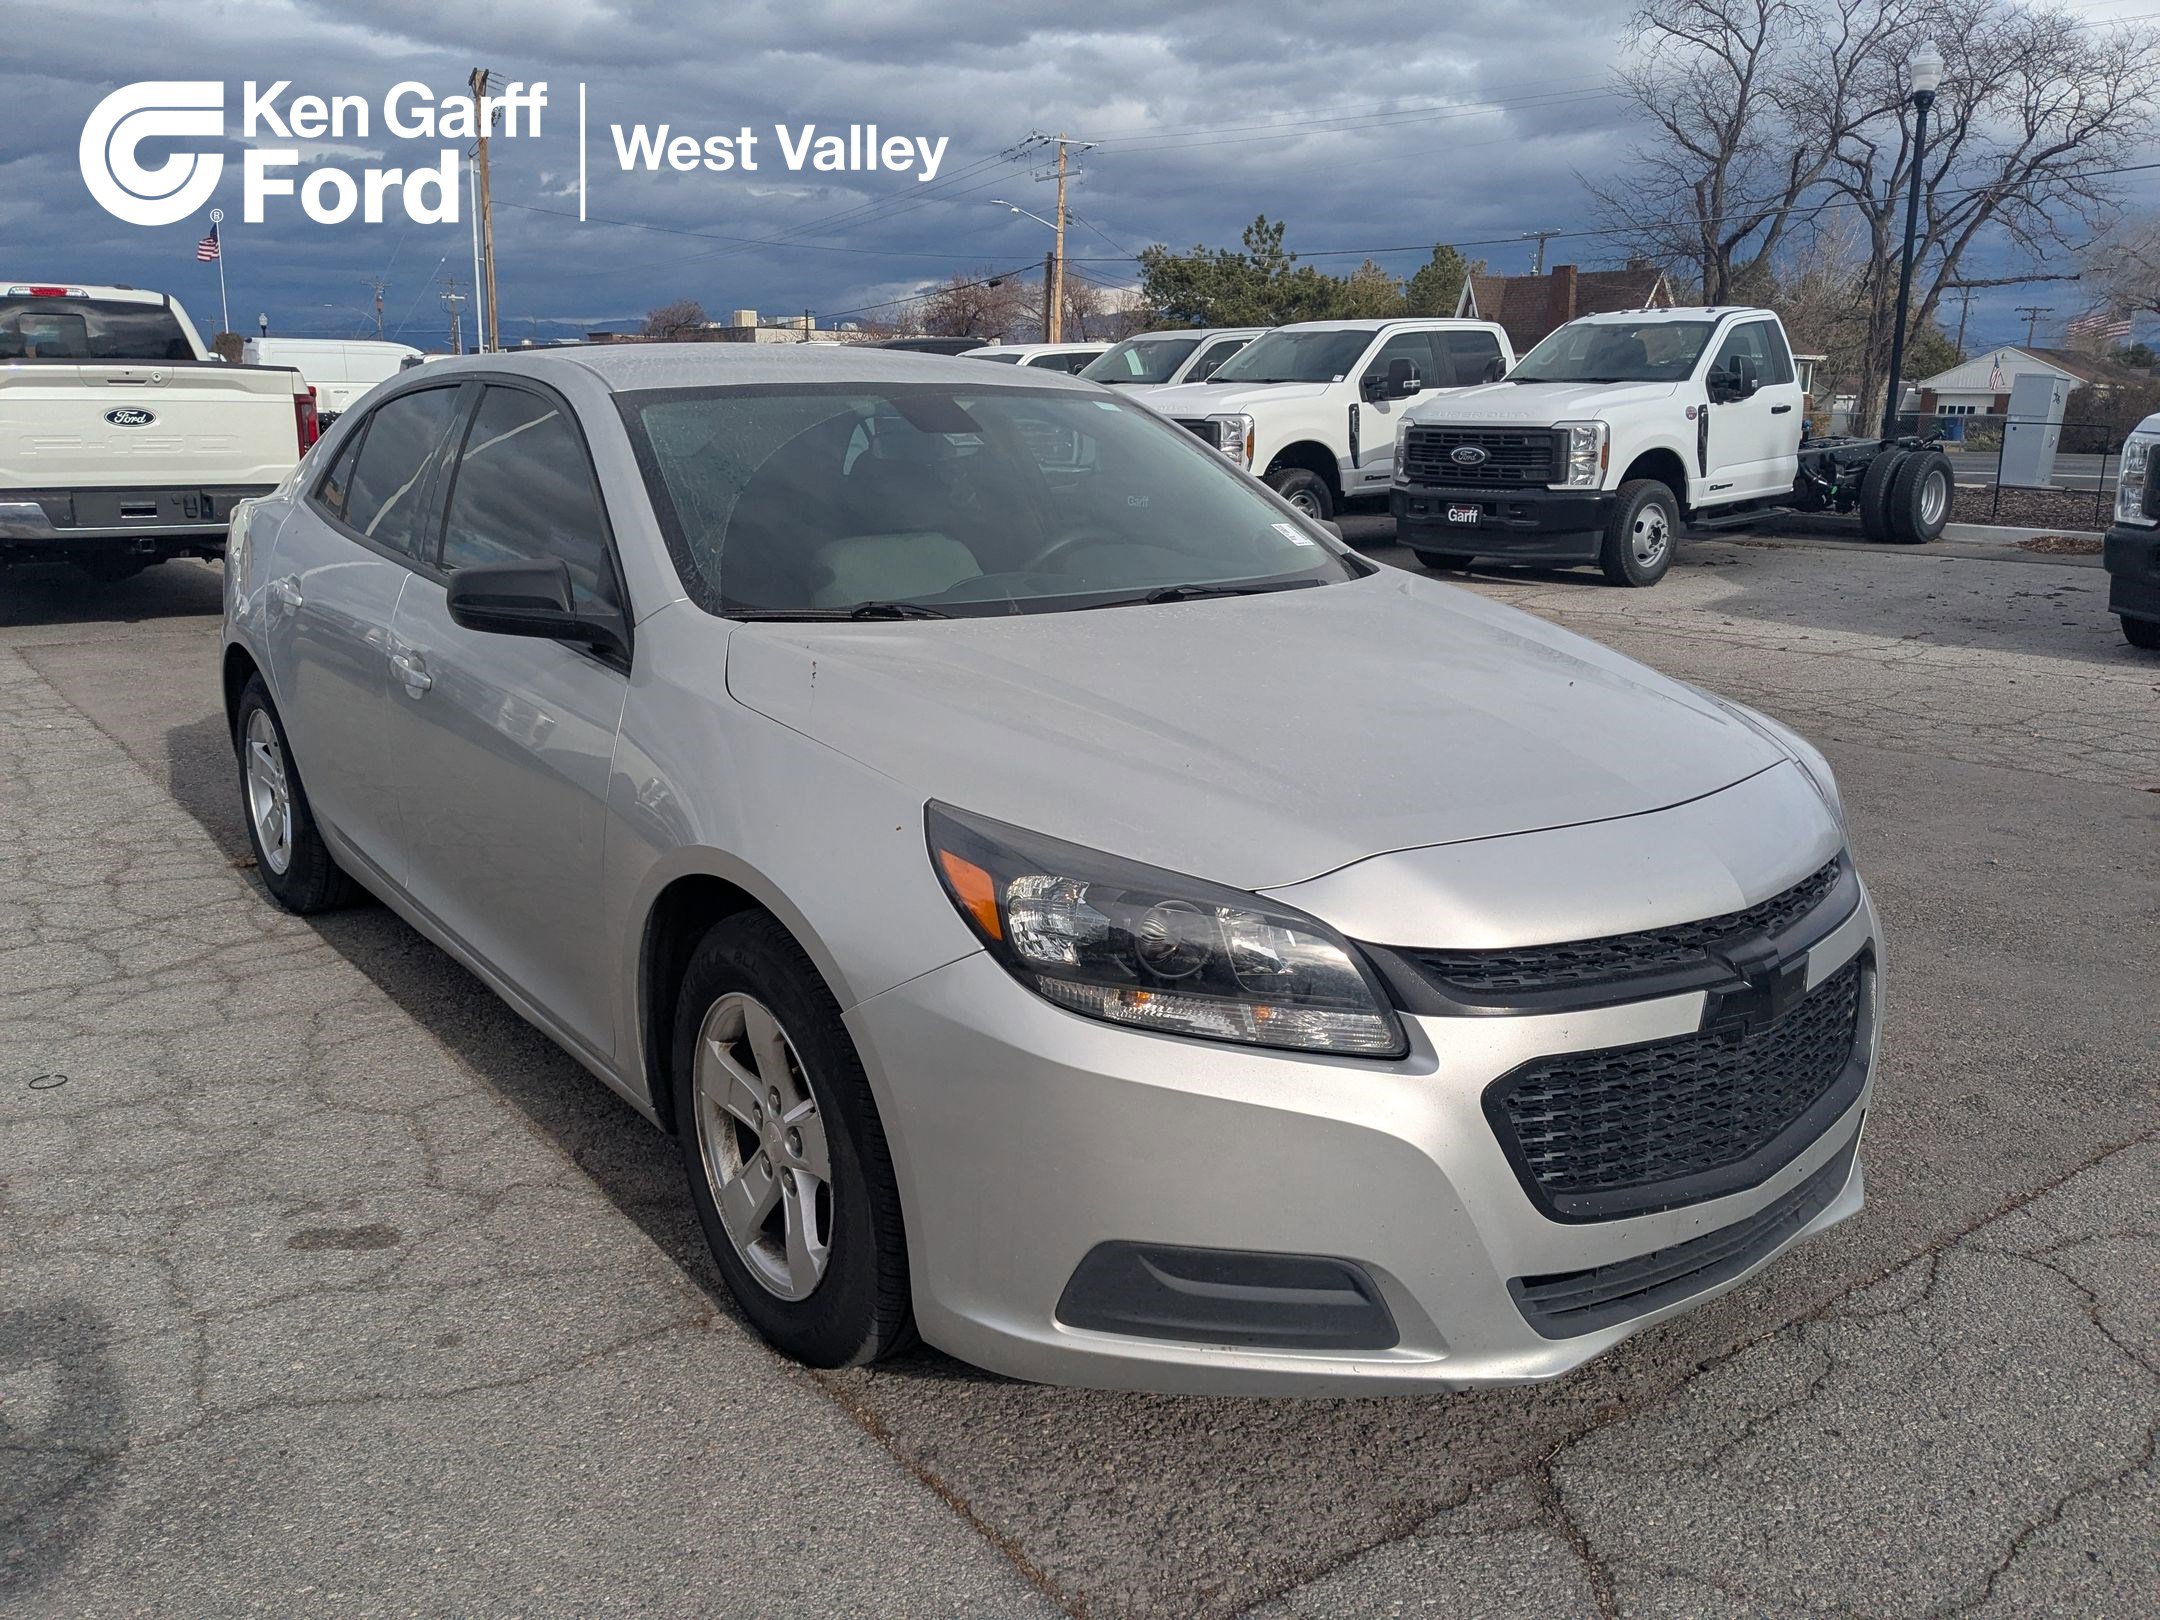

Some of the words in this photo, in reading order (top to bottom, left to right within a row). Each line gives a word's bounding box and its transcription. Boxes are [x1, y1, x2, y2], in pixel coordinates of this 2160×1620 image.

[112, 409, 147, 424] Ford
[1457, 450, 1477, 461] Ford
[1447, 508, 1478, 523] Garff
